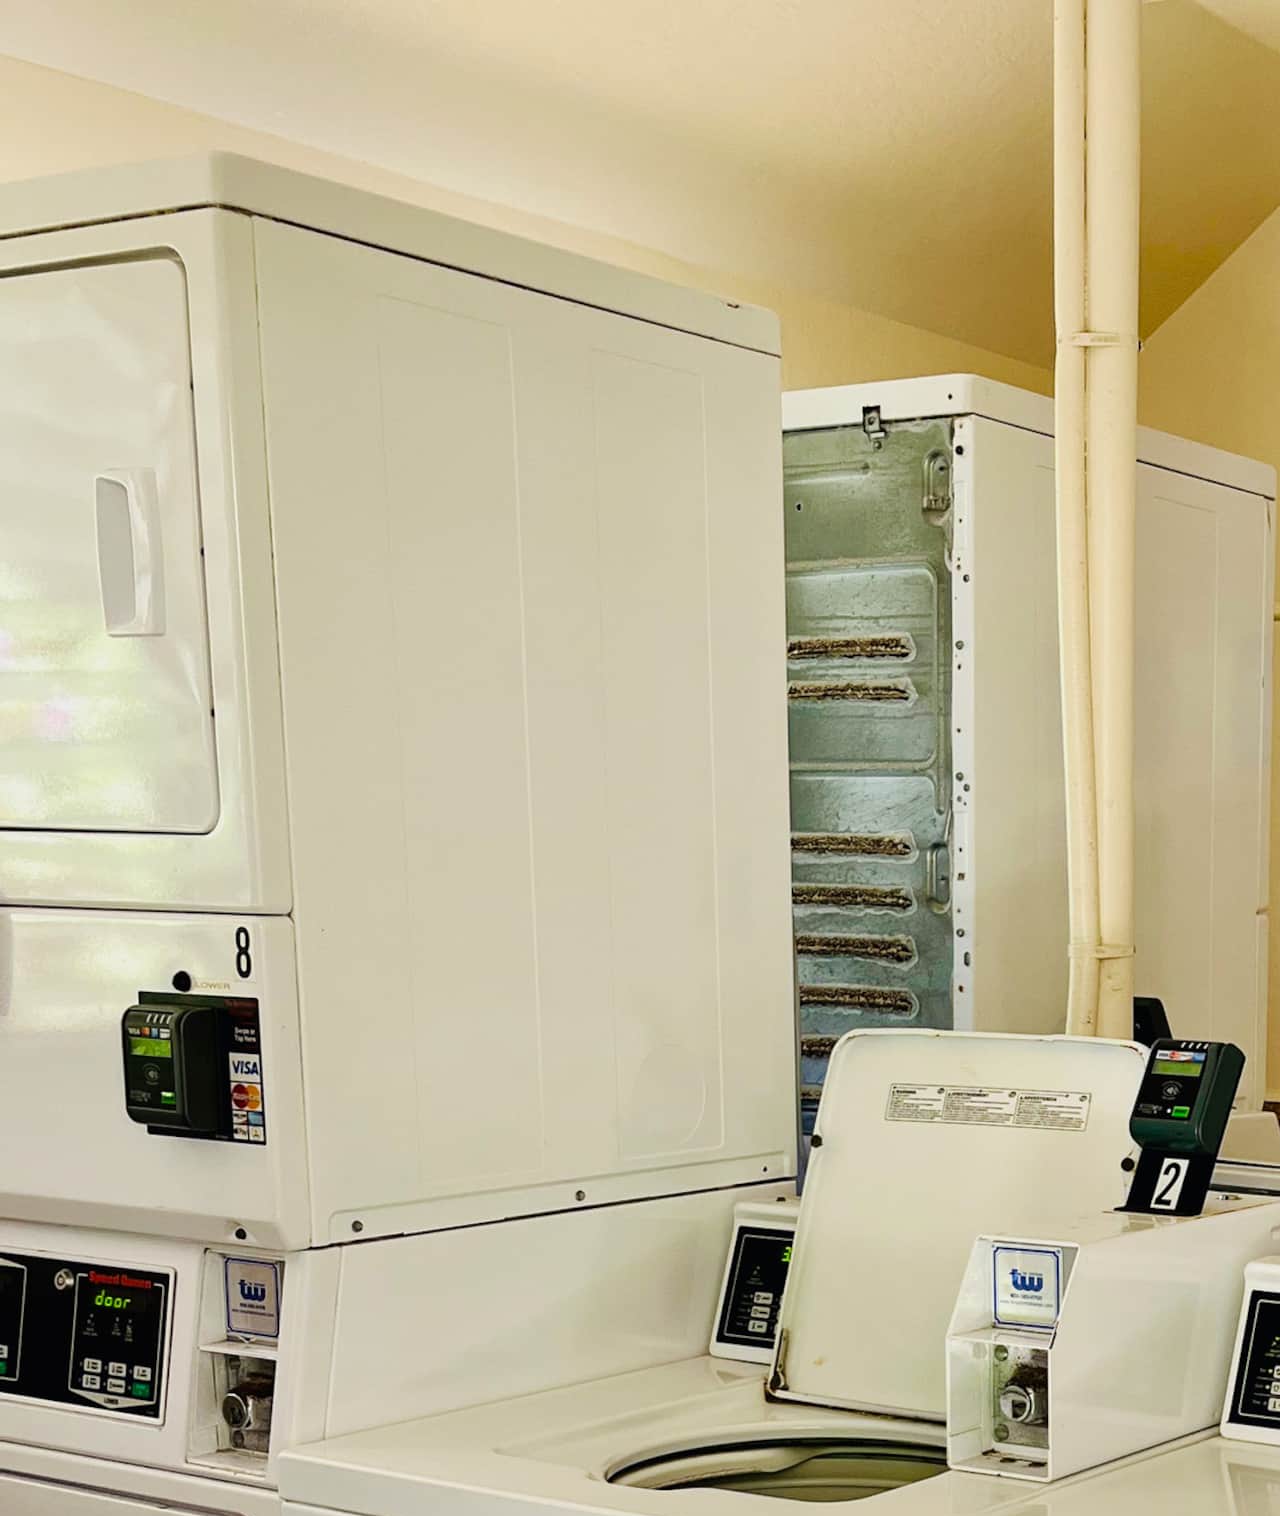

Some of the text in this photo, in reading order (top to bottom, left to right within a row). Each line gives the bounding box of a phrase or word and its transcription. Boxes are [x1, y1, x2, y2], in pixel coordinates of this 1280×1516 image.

[235, 926, 252, 979] 8
[232, 1060, 259, 1075] VISA
[1154, 1162, 1182, 1206] 2
[89, 1270, 120, 1286] Speed
[95, 1289, 131, 1309] door
